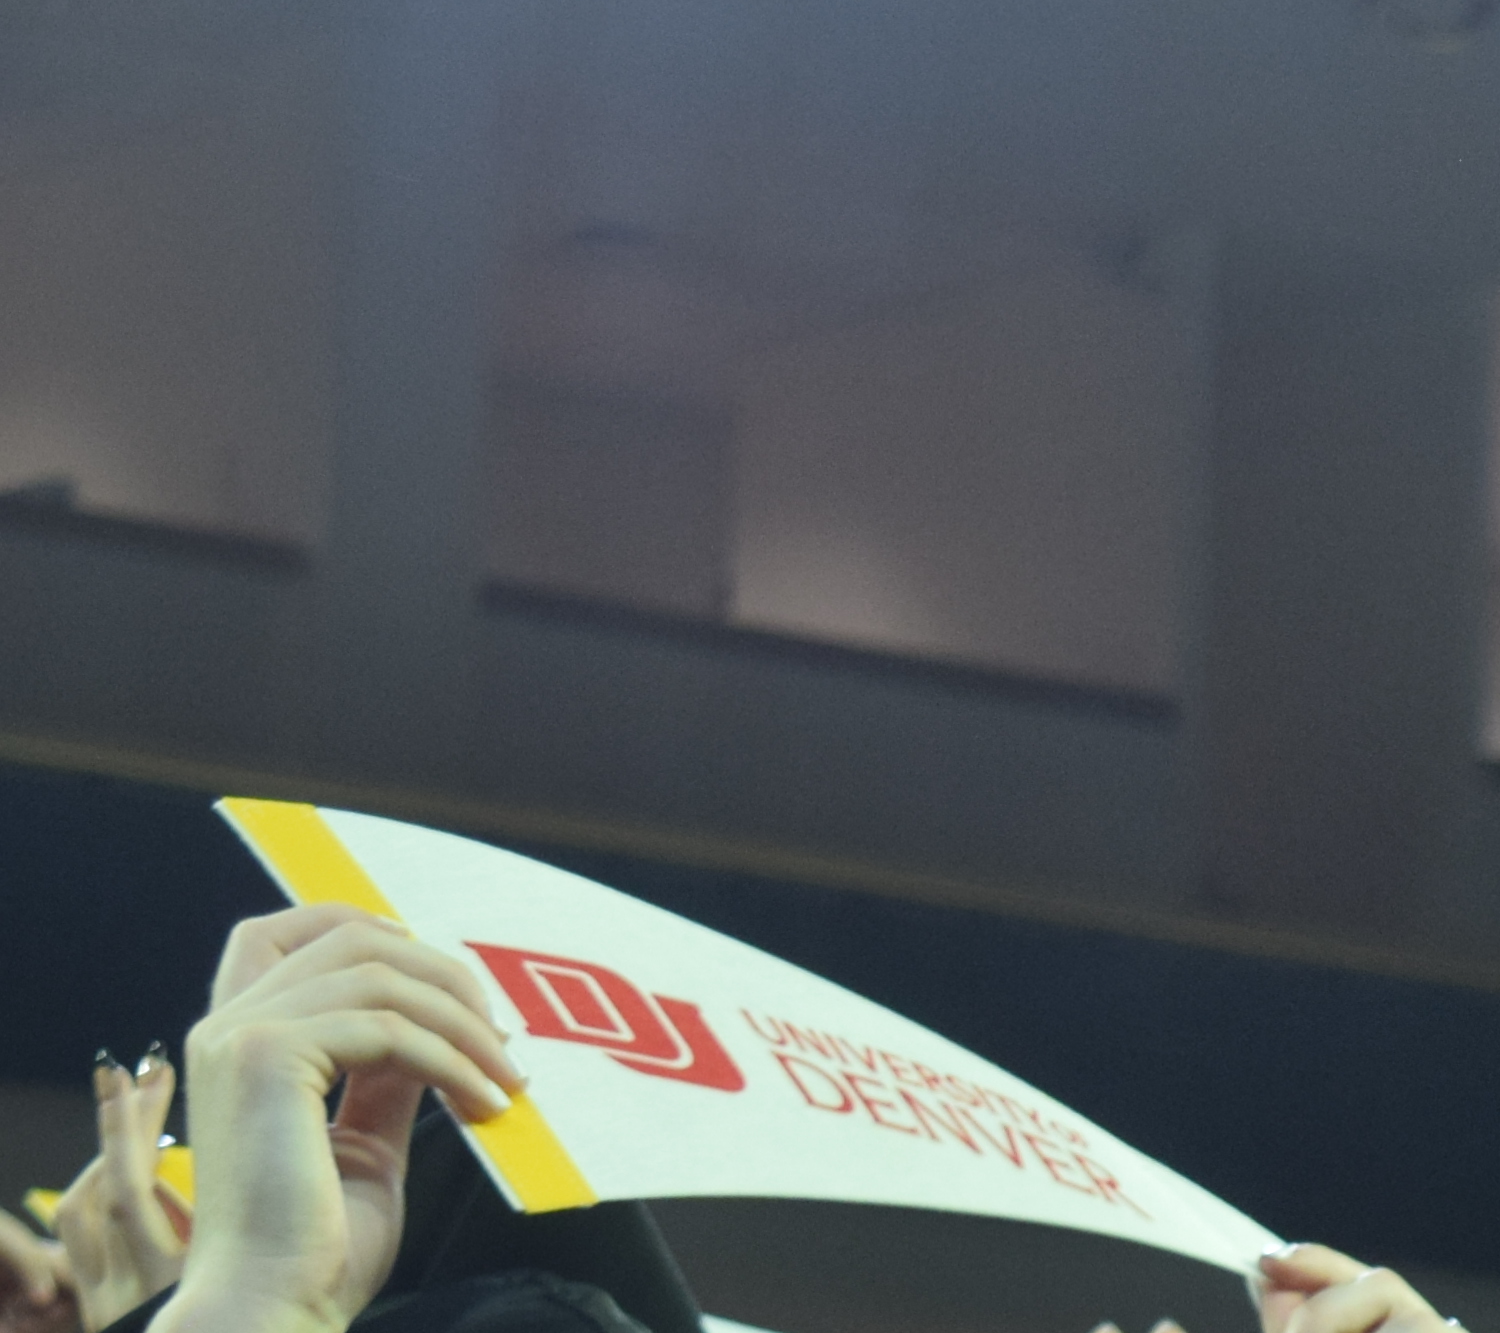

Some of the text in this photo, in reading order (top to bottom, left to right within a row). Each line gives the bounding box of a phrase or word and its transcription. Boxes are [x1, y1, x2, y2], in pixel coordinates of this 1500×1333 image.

[461, 939, 747, 1093] DU
[741, 1008, 1090, 1149] UNIVERSITY OF
[771, 1050, 1154, 1221] DENVER
